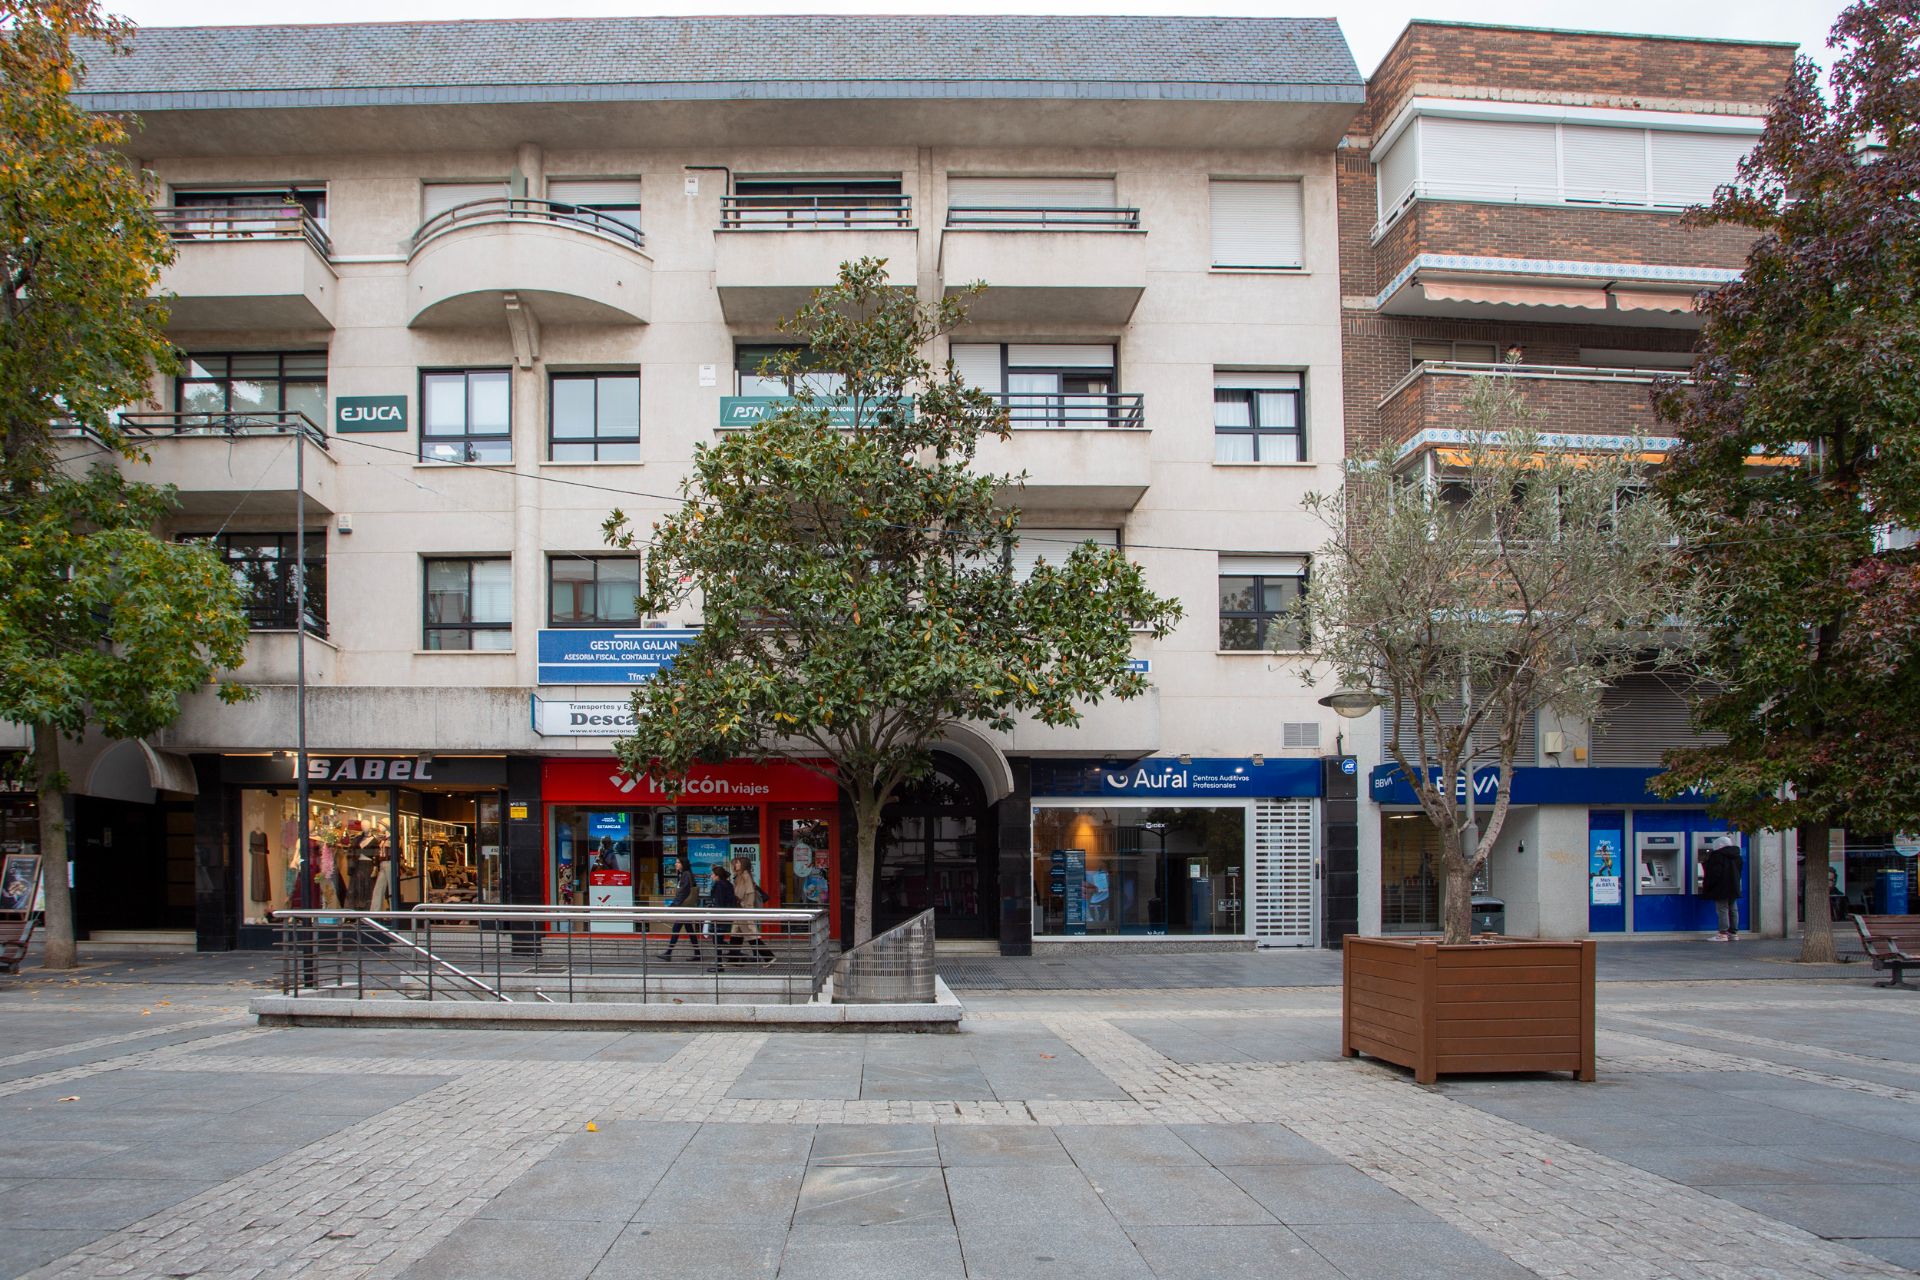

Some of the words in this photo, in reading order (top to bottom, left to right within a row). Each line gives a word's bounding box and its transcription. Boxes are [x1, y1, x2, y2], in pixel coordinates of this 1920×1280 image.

[340, 406, 402, 421] EJUCA
[733, 406, 764, 418] PSN
[590, 641, 640, 651] GESTORIA
[642, 641, 678, 650] GALAN
[596, 654, 620, 662] FISCAL,
[650, 773, 729, 794] Hlcón
[1133, 768, 1187, 788] Aural
[1375, 777, 1393, 788] BBVA
[731, 782, 769, 796] viajes
